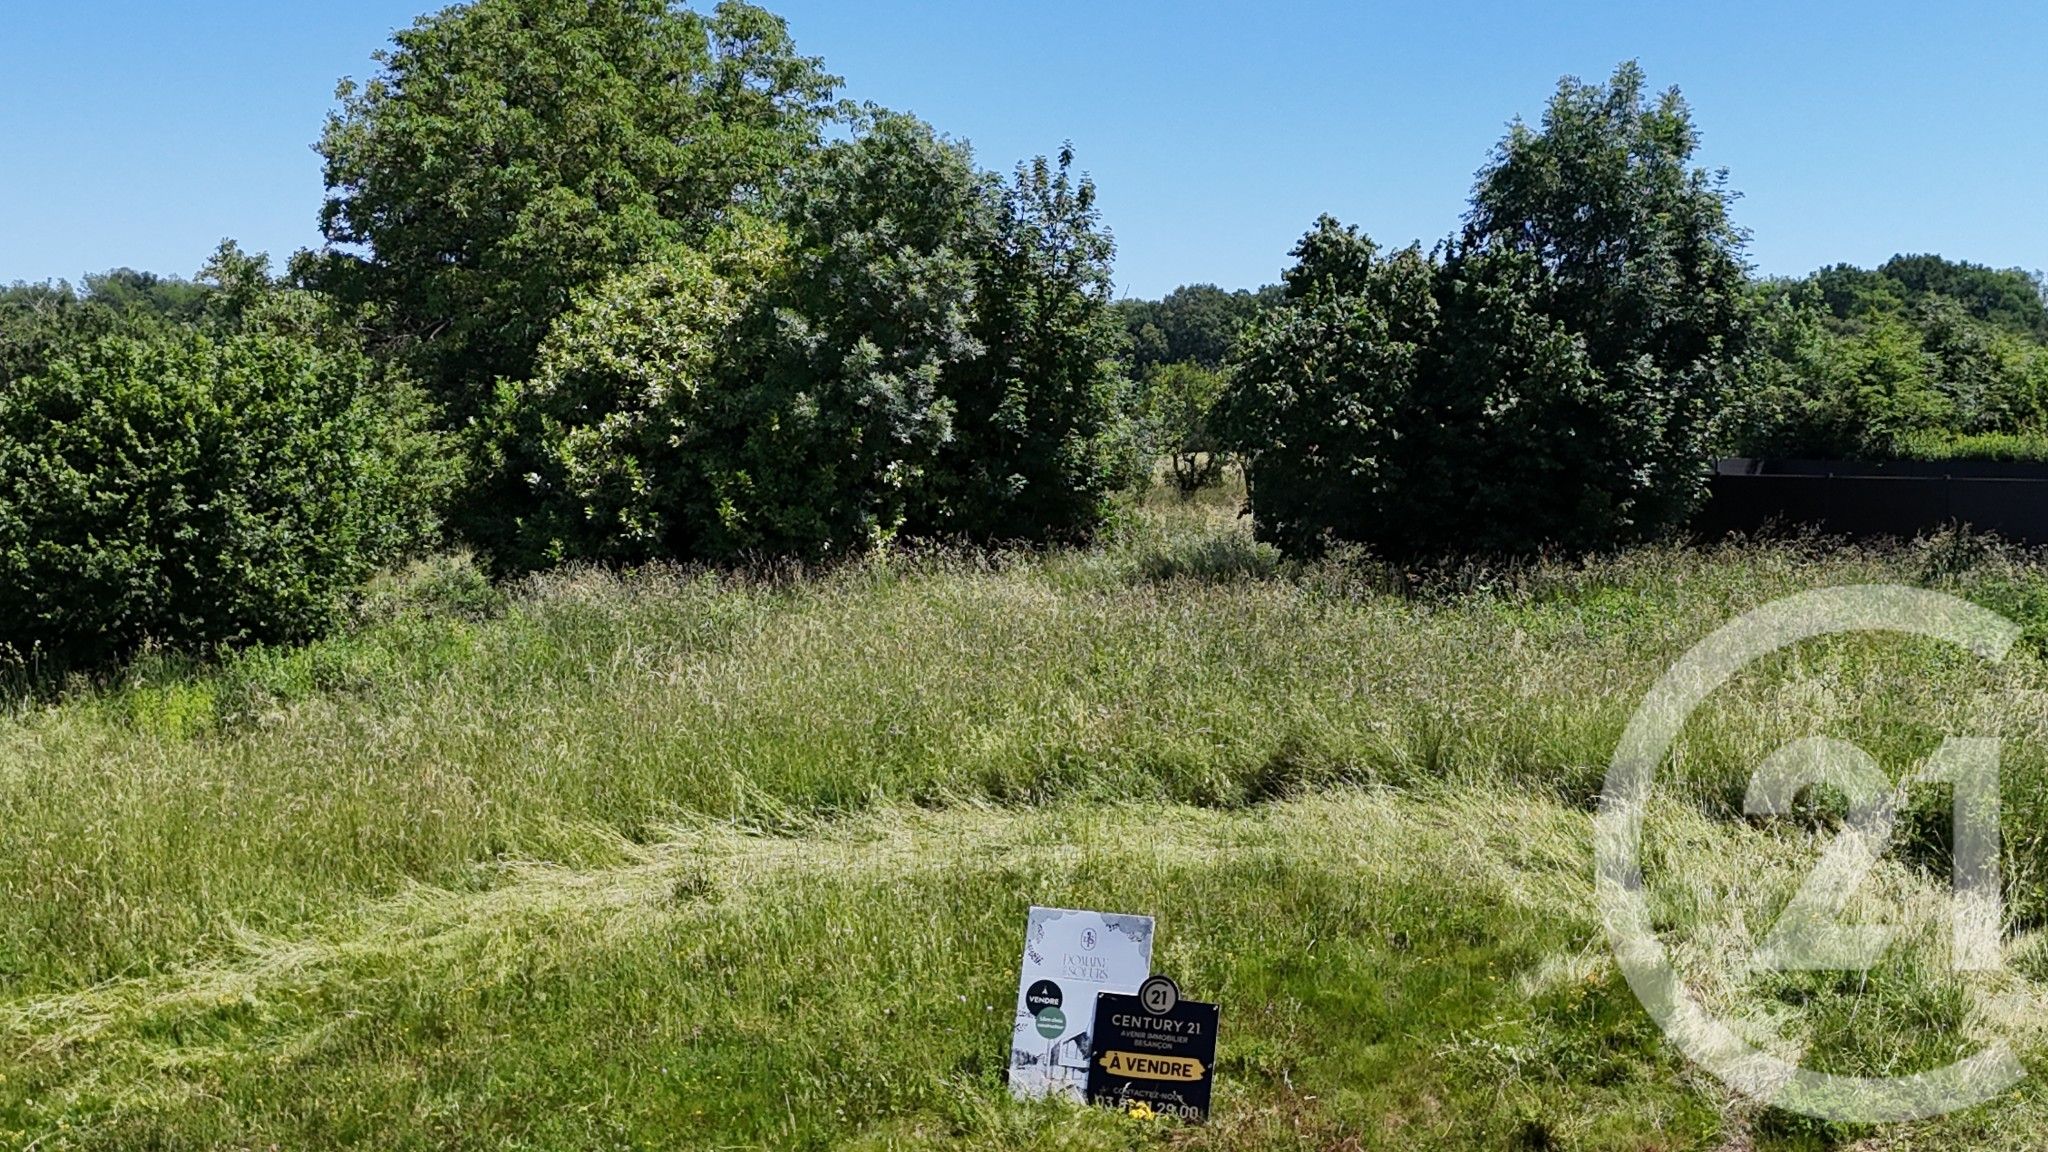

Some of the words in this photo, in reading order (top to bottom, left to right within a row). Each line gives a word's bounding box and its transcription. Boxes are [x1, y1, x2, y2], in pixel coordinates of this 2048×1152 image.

[1029, 996, 1059, 1005] VENDRE
[1151, 990, 1167, 1005] 21
[1111, 1014, 1184, 1033] CENTURY
[1187, 1022, 1201, 1035] 21
[1120, 1030, 1146, 1039] AVENIR
[1147, 1033, 1188, 1044] IMMOBILIER
[1133, 1039, 1173, 1050] BESANÇON
[1109, 1052, 1121, 1070] À
[1125, 1056, 1193, 1078] VENDRE
[1179, 1104, 1199, 1120] 00
